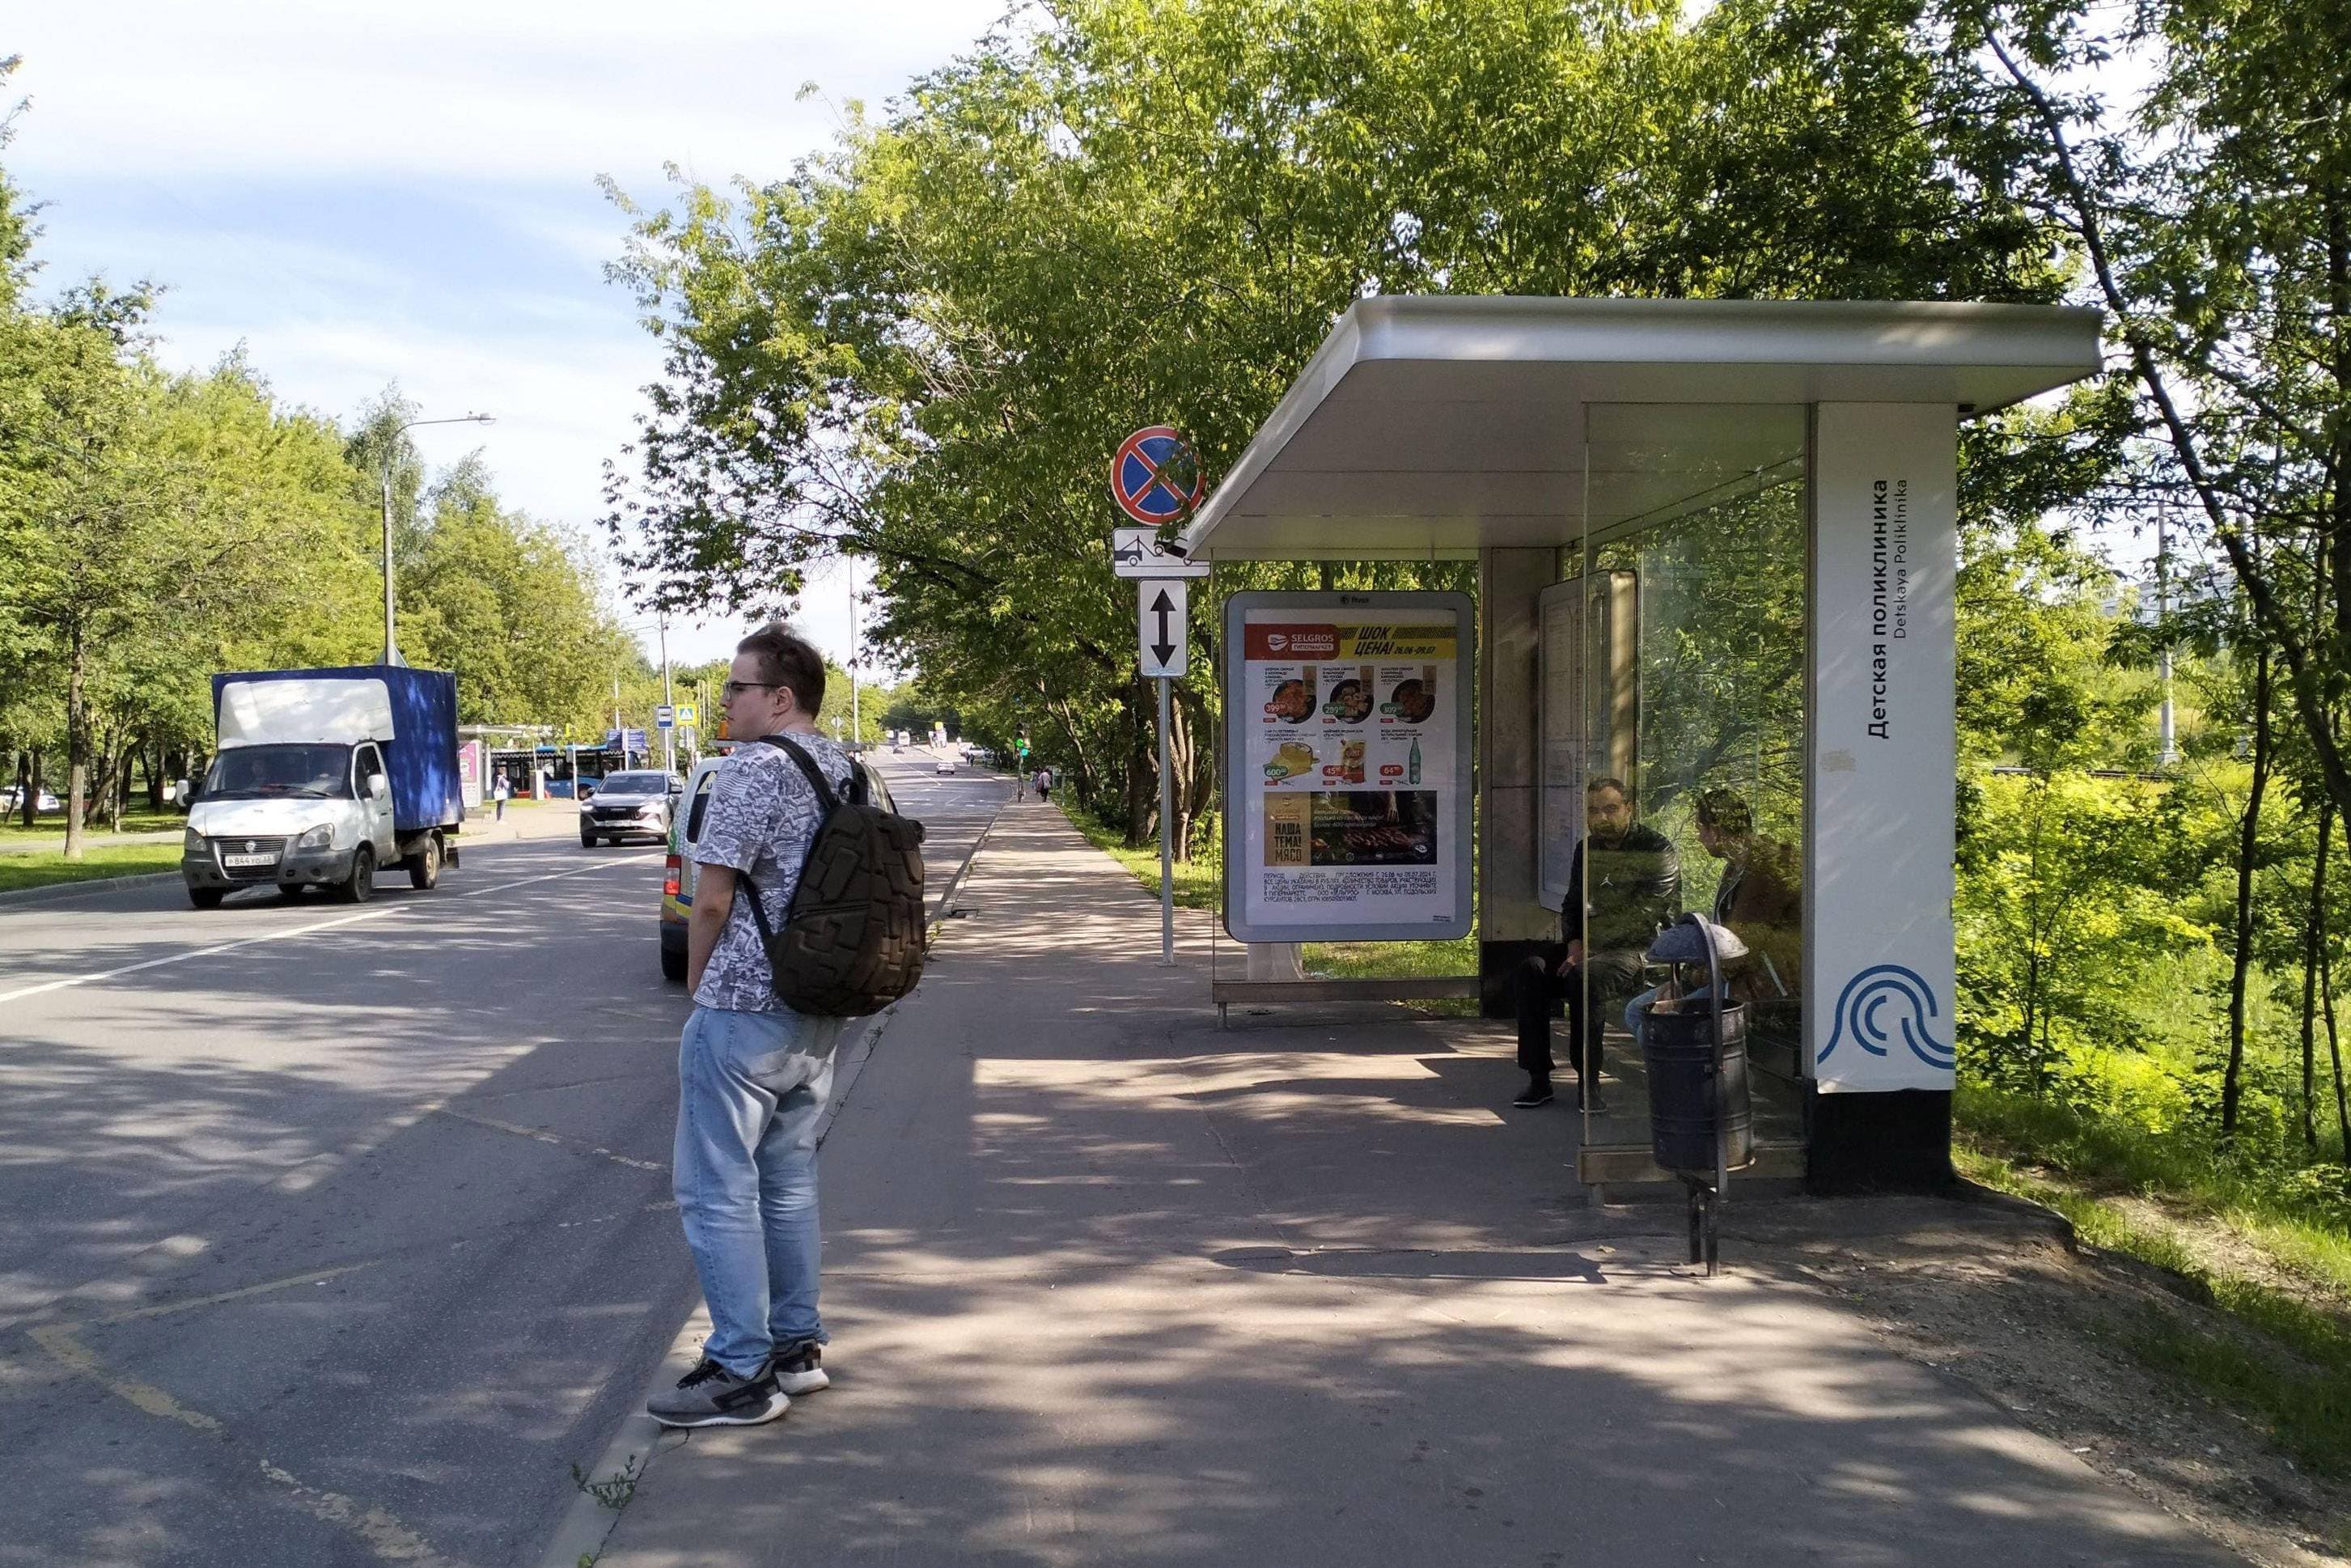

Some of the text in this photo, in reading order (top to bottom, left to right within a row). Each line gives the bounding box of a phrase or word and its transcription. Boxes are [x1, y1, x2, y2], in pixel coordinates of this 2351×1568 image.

[1894, 479, 1907, 638] Detskaya Poliklinika
[1868, 480, 1889, 740] Детская поликлиника
[1291, 634, 1334, 643] SELGROS
[1358, 626, 1388, 640] ШОК
[1354, 642, 1395, 656] ЦЕНА!
[1275, 822, 1301, 835] НАША
[1275, 836, 1302, 849] ТЕМА!
[1275, 849, 1302, 862] МЯСО
